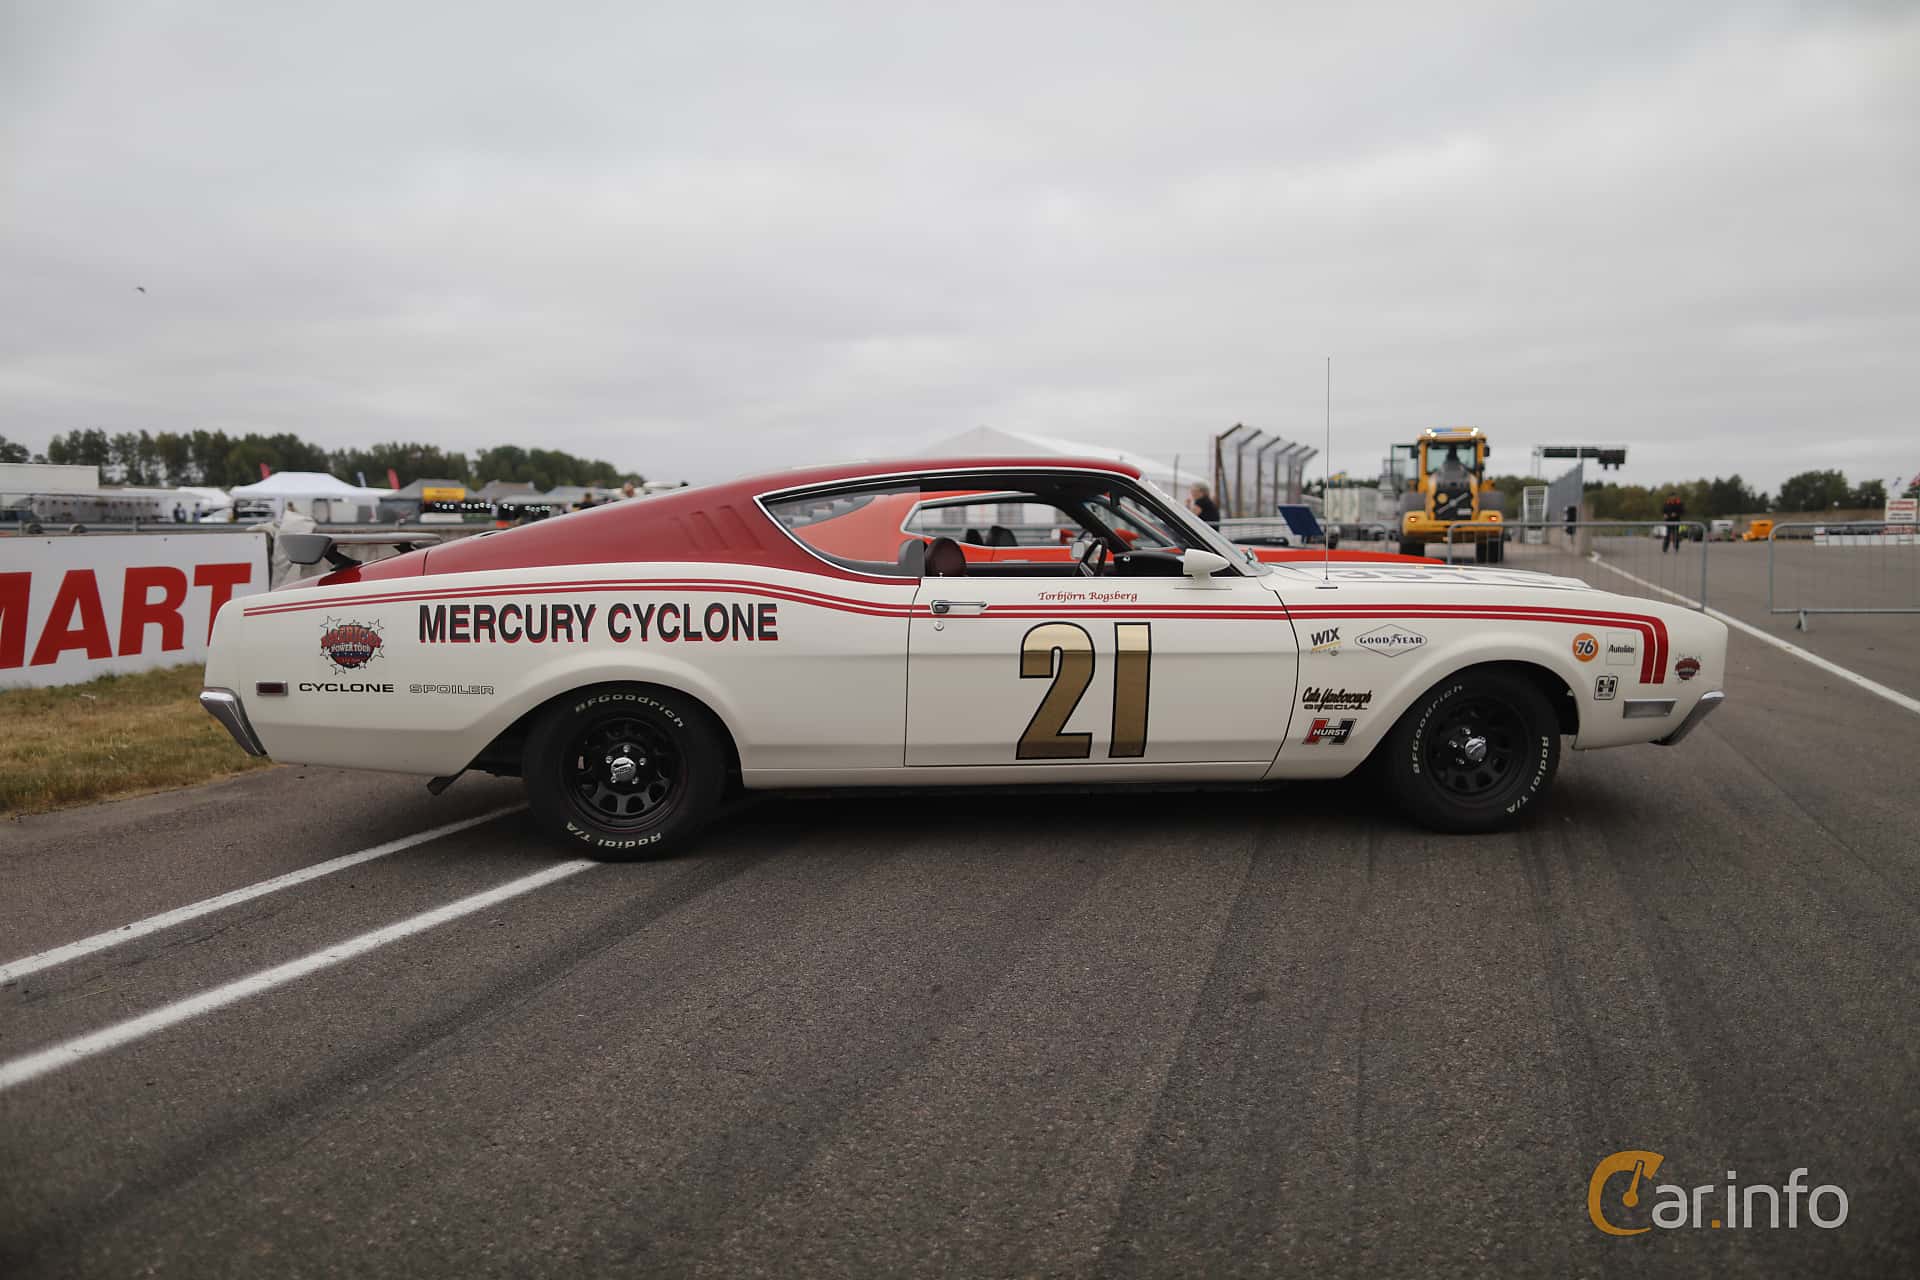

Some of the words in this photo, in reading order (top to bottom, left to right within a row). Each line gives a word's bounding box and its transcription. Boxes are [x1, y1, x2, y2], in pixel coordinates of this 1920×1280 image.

[1038, 590, 1086, 603] Torbjörn
[1088, 590, 1138, 603] Rogsberg
[418, 603, 597, 644] MERCURY
[607, 602, 779, 643] CYCLONE
[1311, 627, 1340, 646] WIX
[1576, 639, 1595, 655] 76
[299, 682, 395, 693] CYCLONE
[409, 683, 495, 695] SPOILER
[1016, 621, 1152, 760] 21
[1312, 728, 1348, 736] HURST
[1530, 736, 1550, 793] Radial
[597, 832, 662, 849] Radial
